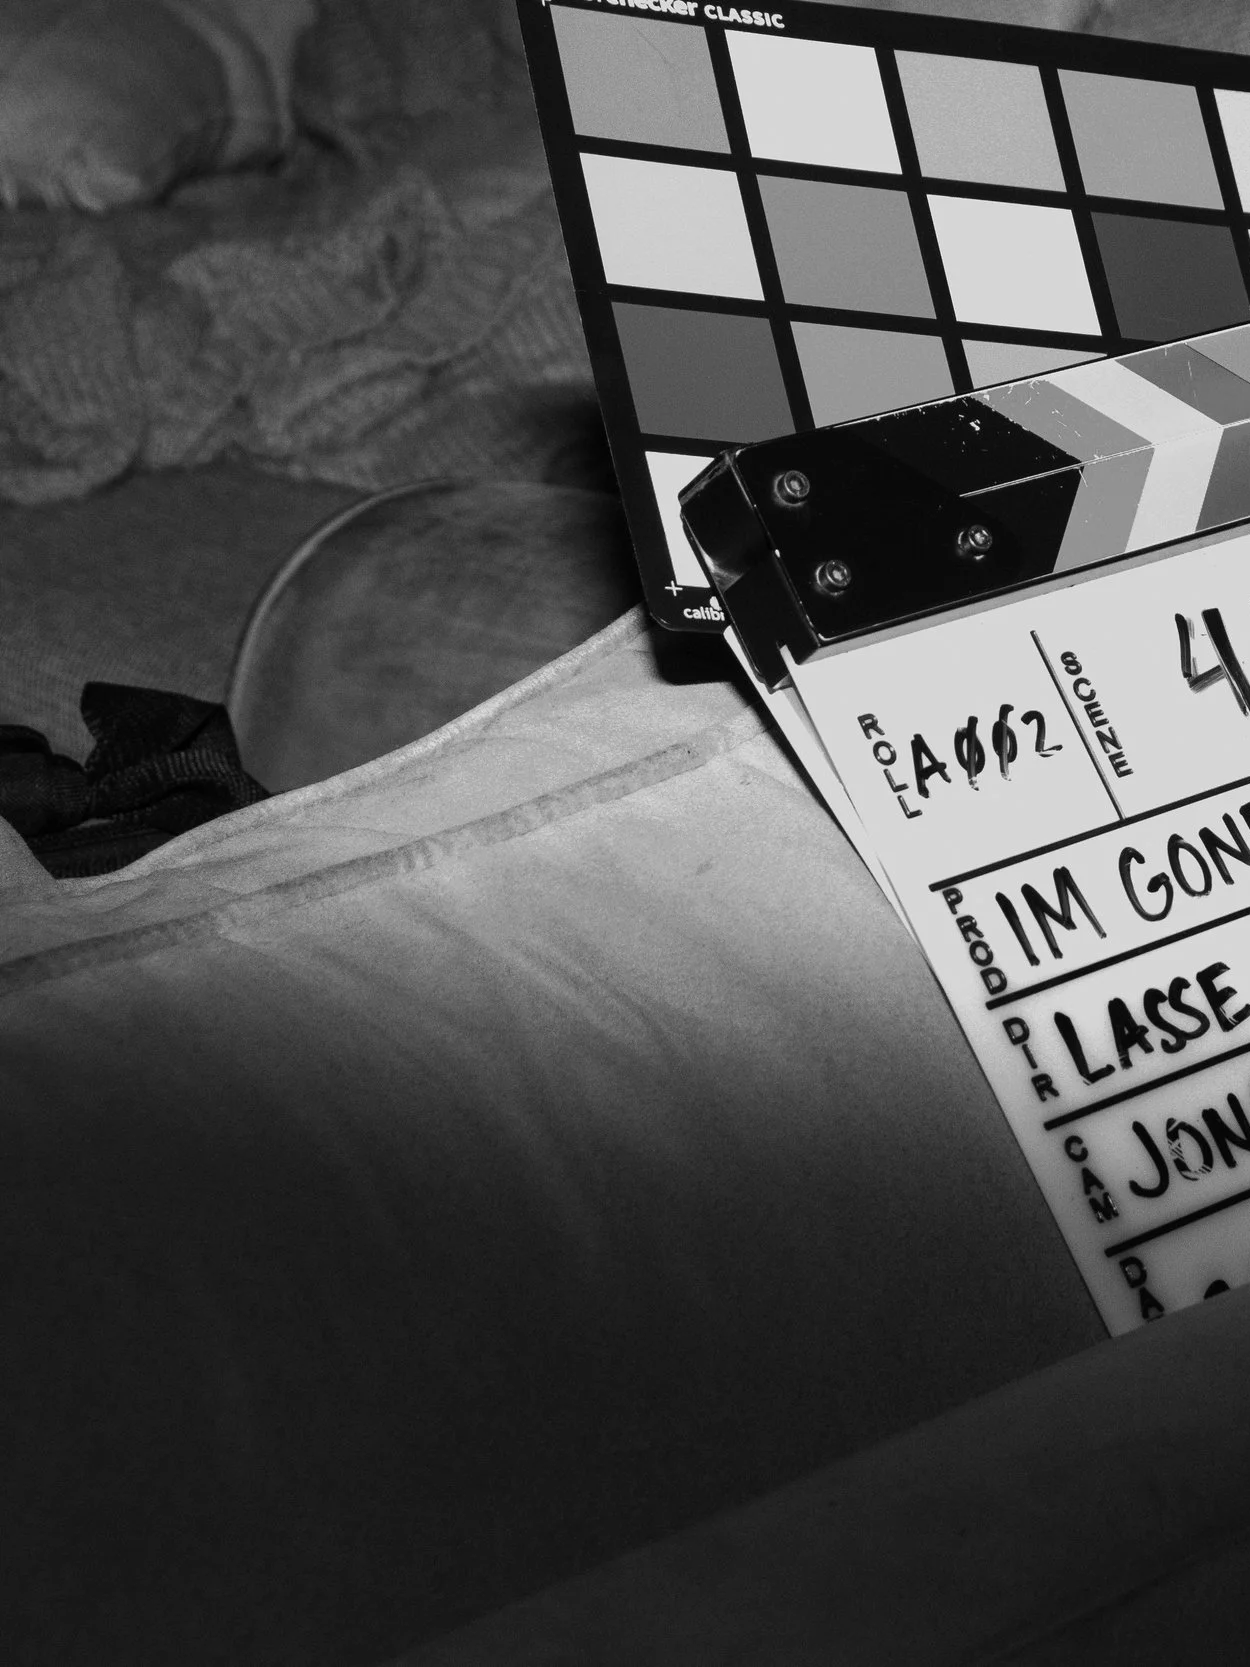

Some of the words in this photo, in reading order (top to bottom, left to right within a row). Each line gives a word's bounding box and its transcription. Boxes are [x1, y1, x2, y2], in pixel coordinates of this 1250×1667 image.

[704, 4, 785, 29] CLASSIC
[1060, 650, 1134, 778] SCENE
[857, 713, 923, 819] ROLL
[942, 887, 1007, 995] PROD
[995, 866, 1107, 967] IM
[1002, 1016, 1060, 1101] DIR
[1063, 1134, 1120, 1224] CAM
